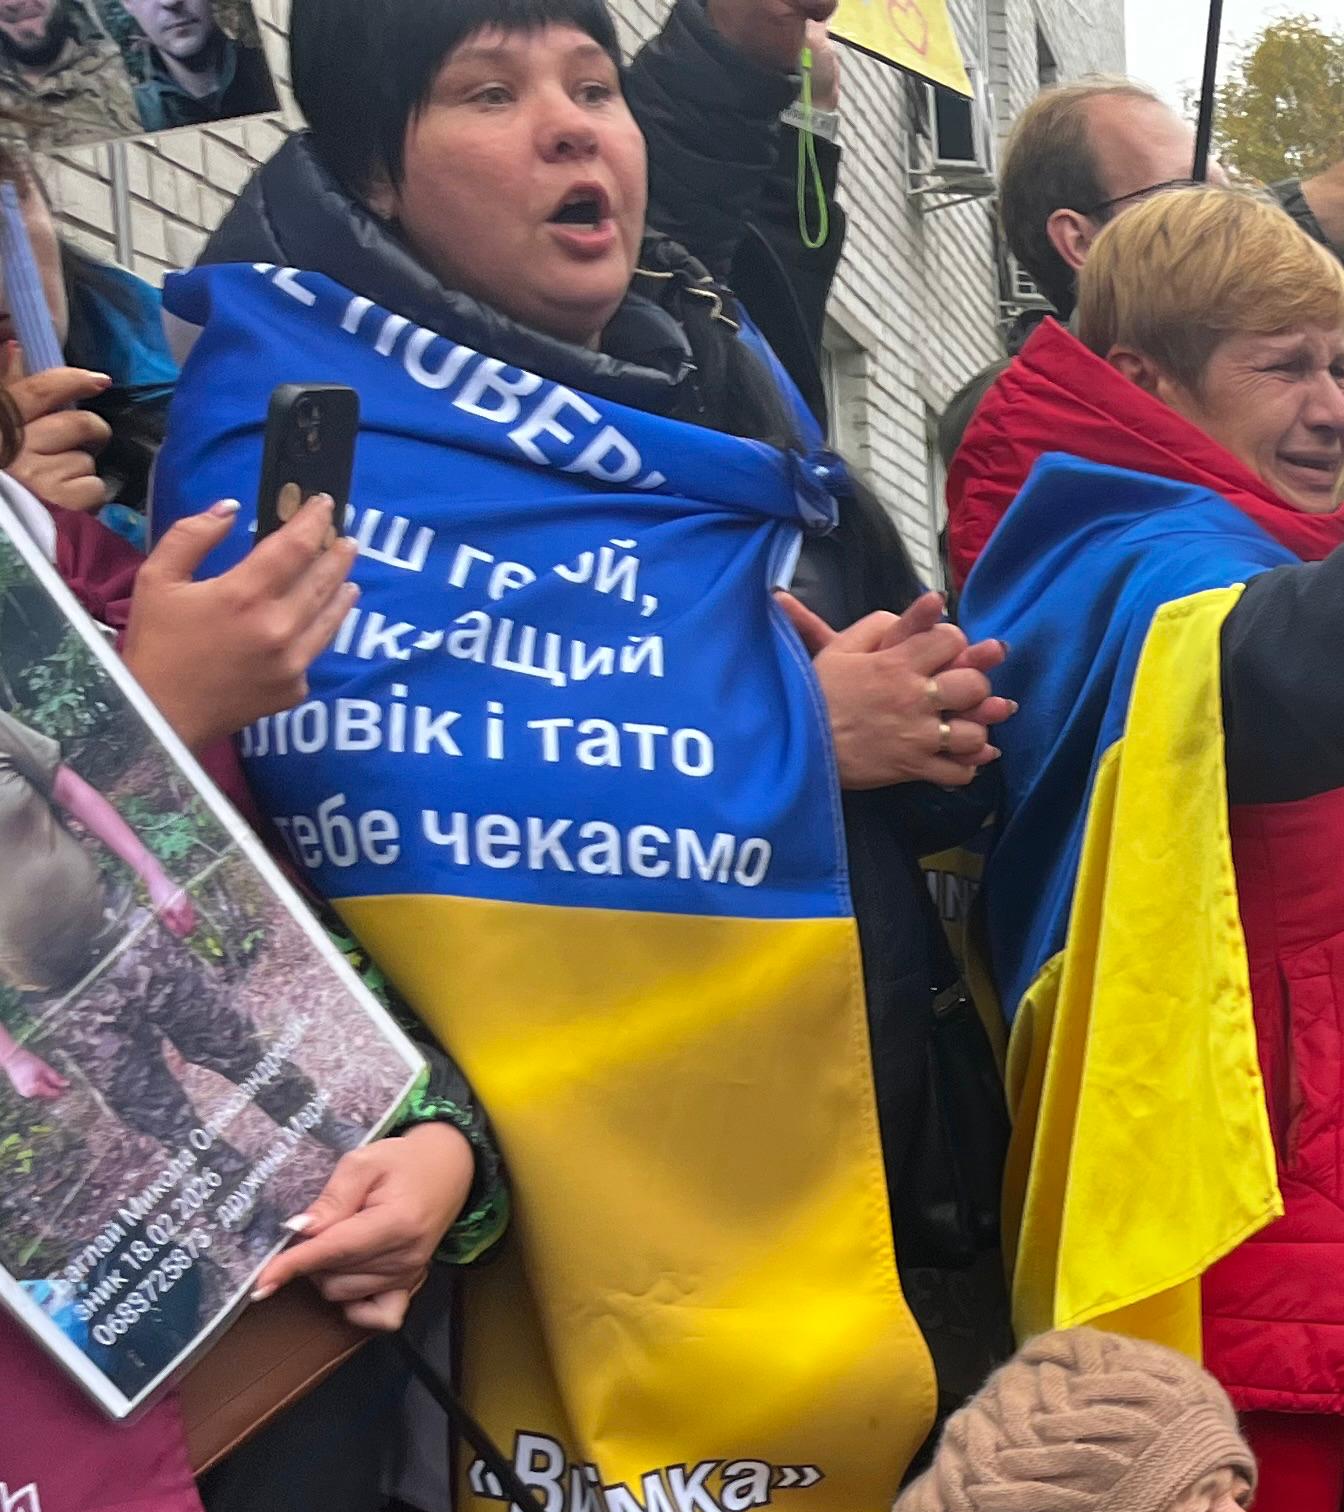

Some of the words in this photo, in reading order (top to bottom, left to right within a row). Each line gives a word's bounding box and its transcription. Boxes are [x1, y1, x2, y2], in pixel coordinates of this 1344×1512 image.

[241, 683, 463, 758] ловік
[486, 700, 503, 760] і
[527, 716, 716, 778] тато
[422, 808, 773, 888] чекаємо
